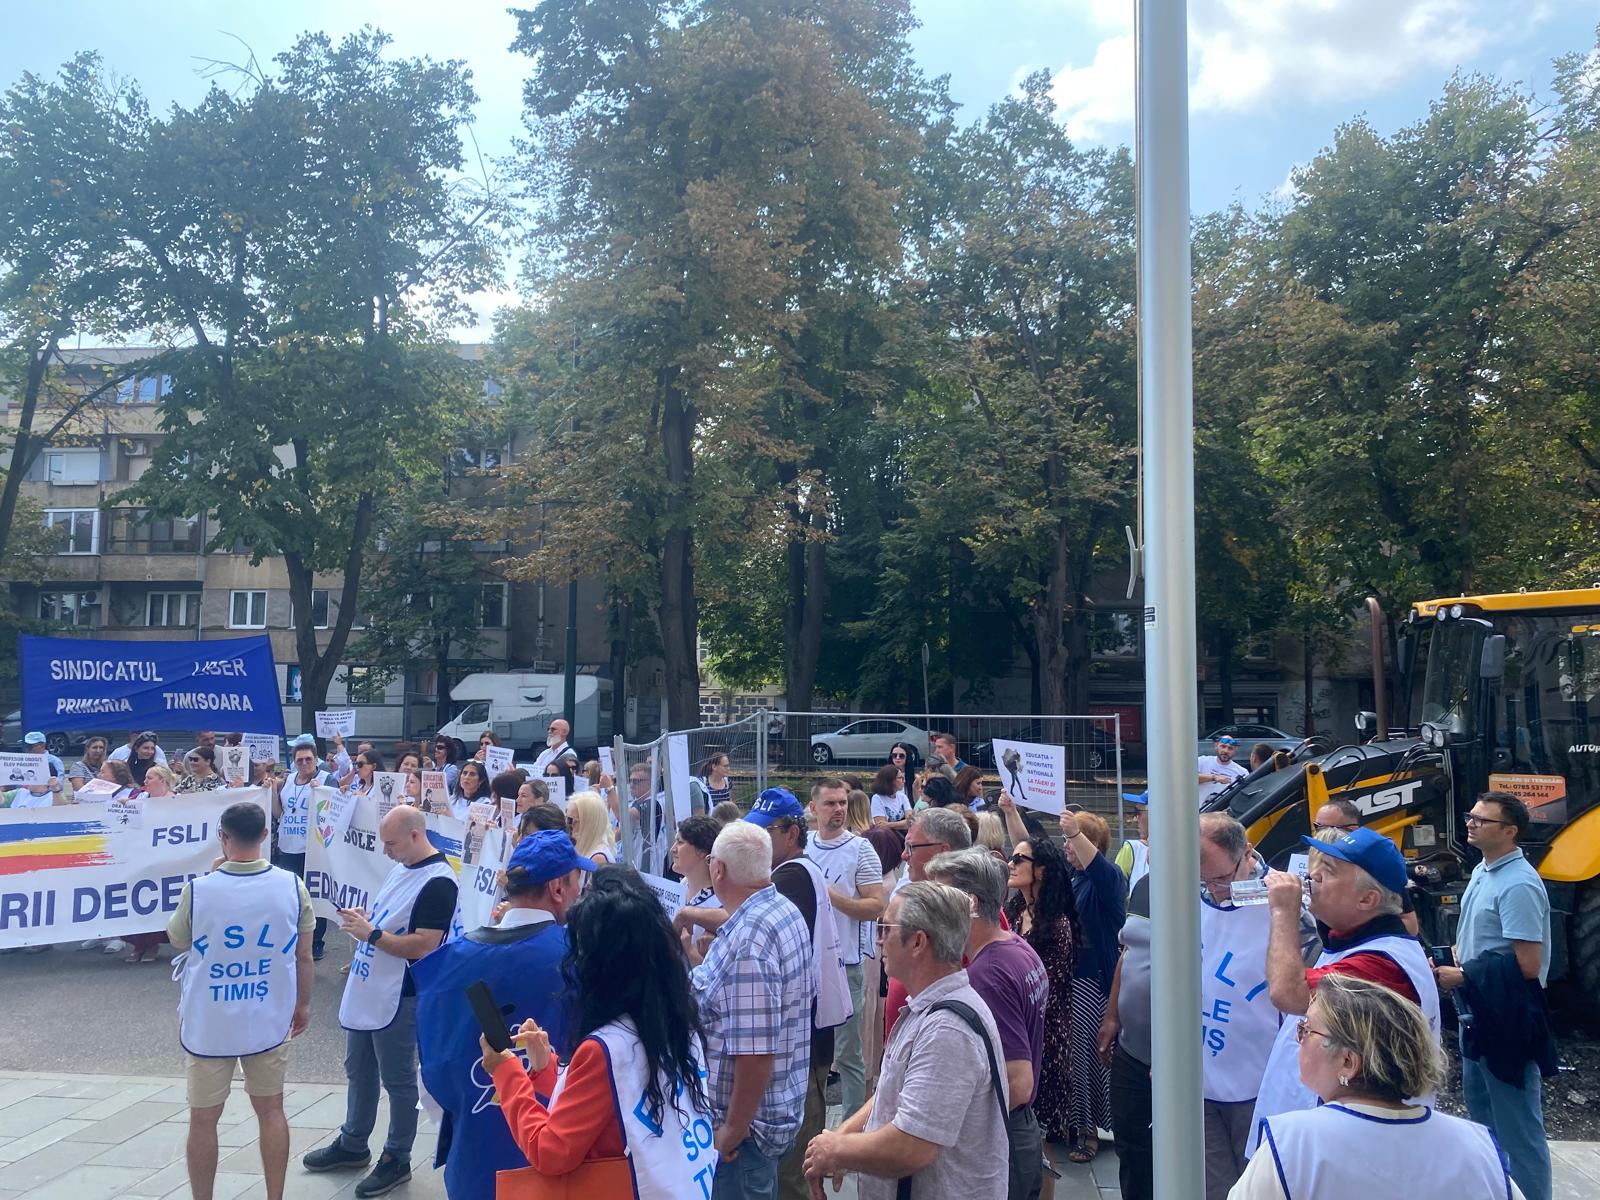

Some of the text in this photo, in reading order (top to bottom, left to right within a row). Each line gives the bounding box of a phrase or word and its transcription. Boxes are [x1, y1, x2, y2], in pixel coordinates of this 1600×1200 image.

[50, 659, 163, 682] SINDICATUL
[56, 692, 254, 715] PRIMARIA TIMISOARA
[283, 815, 308, 825] SOLE
[152, 822, 208, 847] FSLI
[209, 958, 272, 979] SOLE
[208, 980, 269, 1002] TIMIȘ
